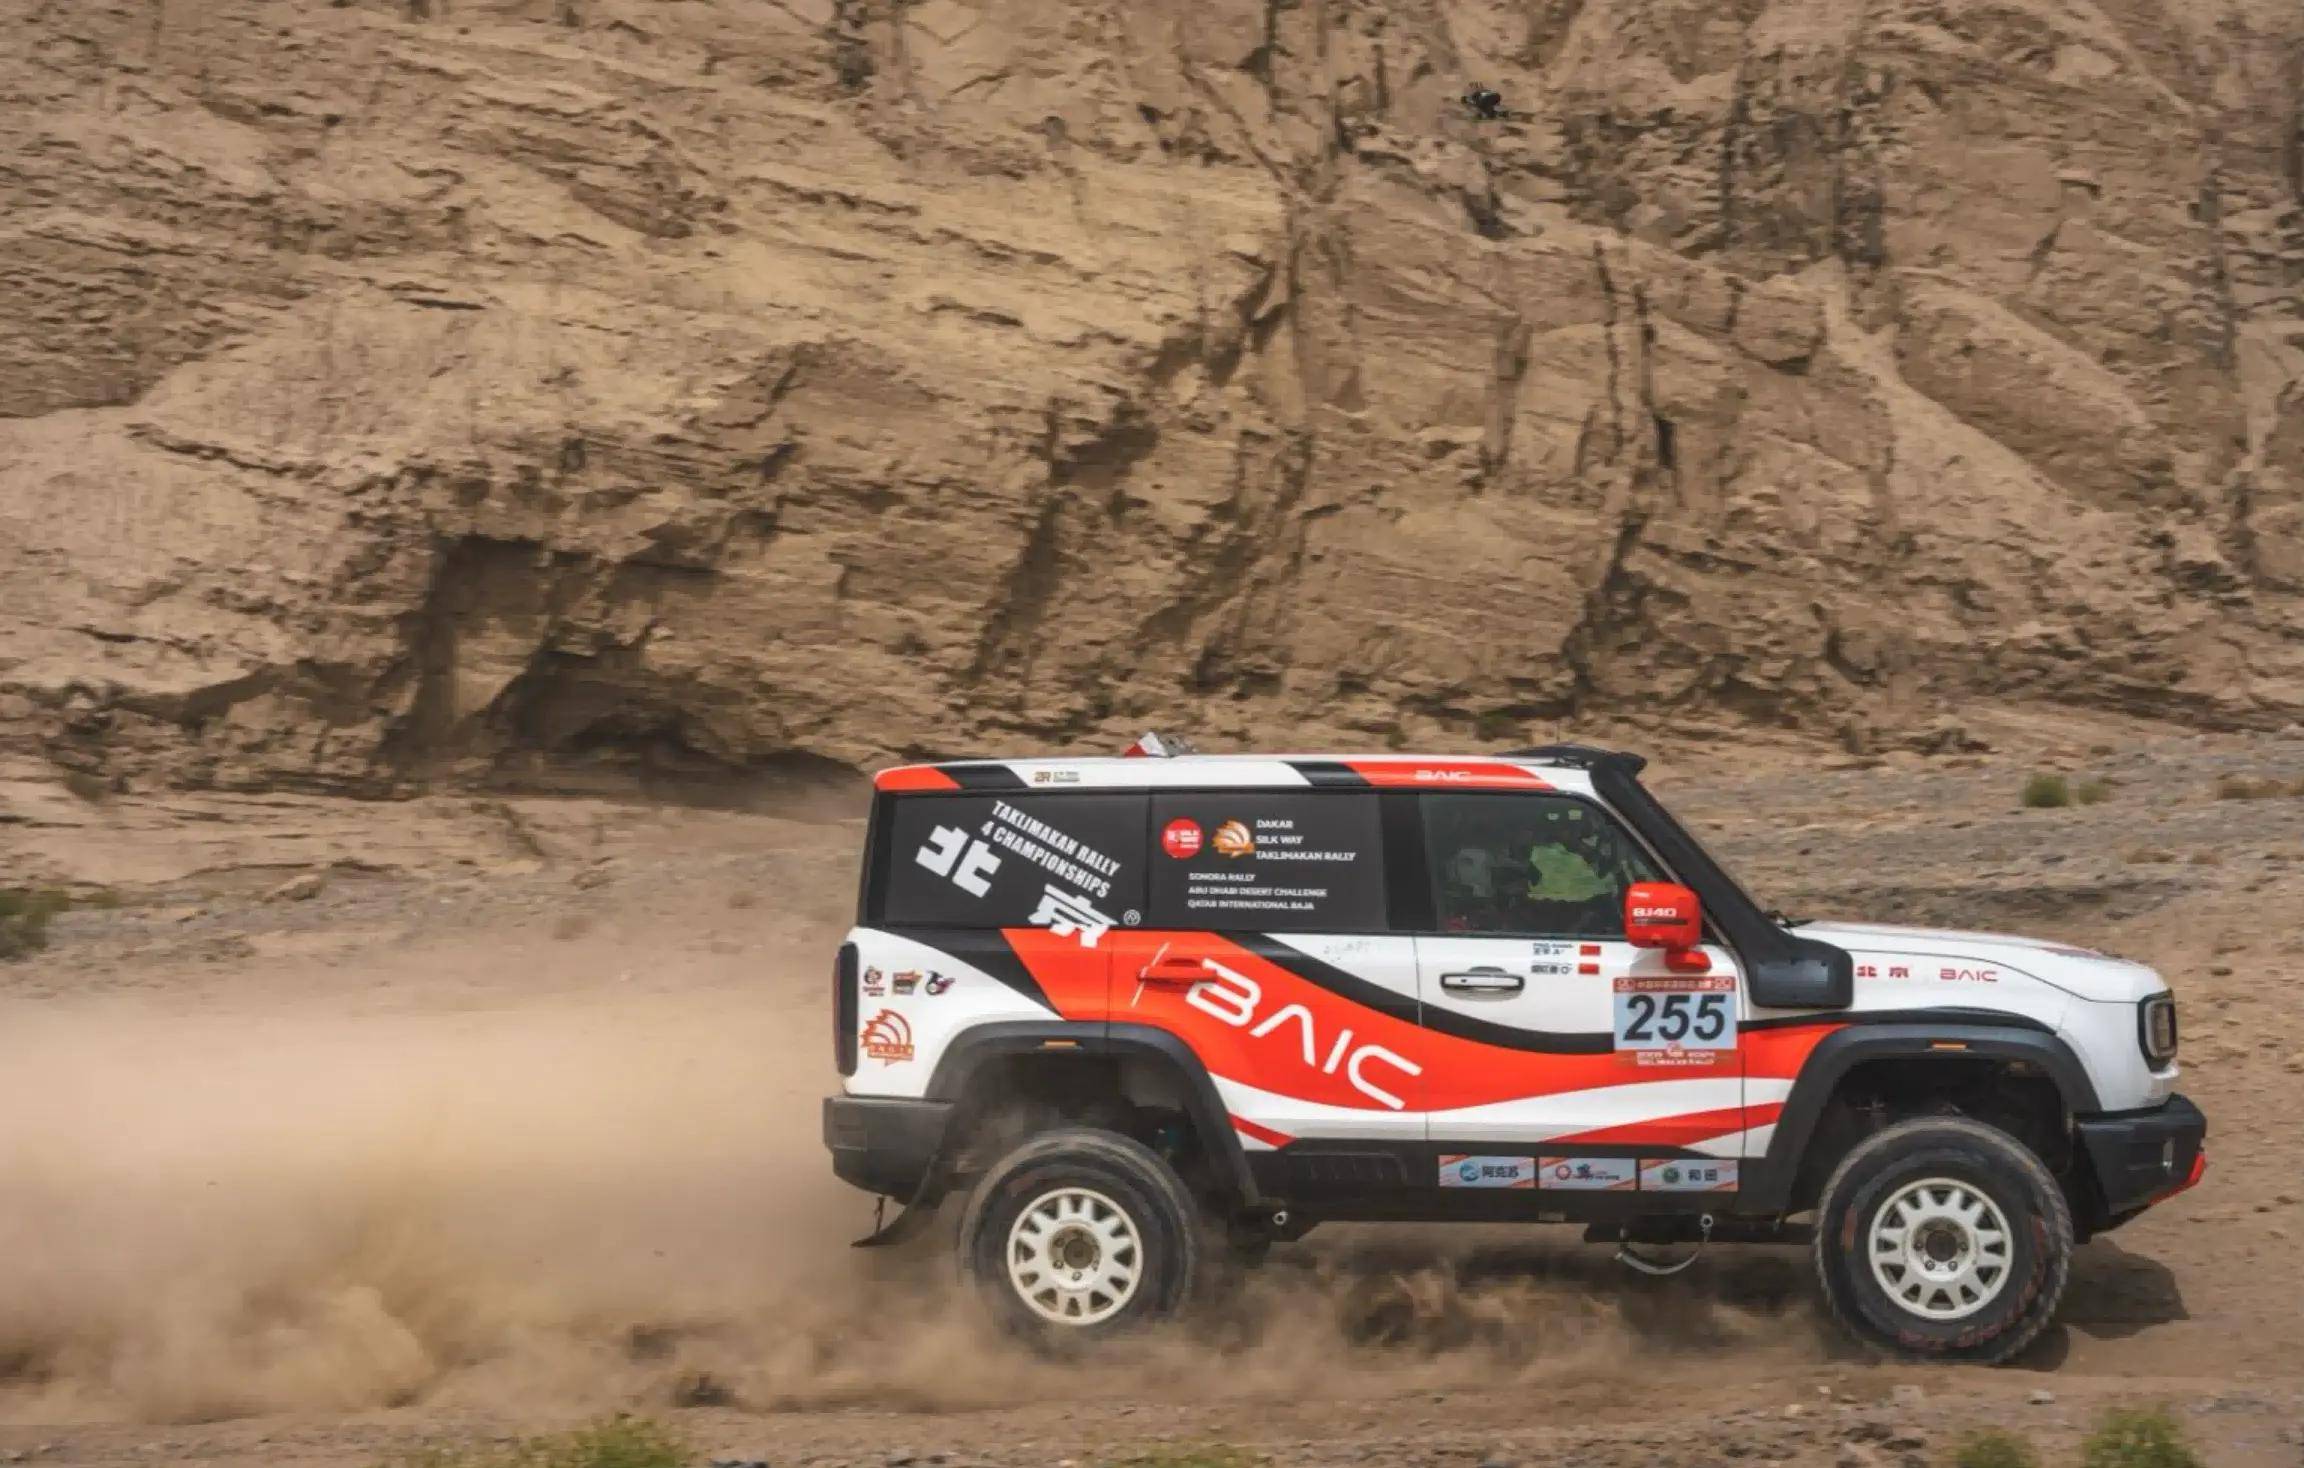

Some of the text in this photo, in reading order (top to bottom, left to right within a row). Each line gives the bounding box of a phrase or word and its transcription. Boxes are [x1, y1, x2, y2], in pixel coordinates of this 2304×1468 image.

[1256, 819, 1294, 830] DAKAR
[992, 800, 1121, 877] TAKLIMAKAN RALLY
[1256, 835, 1304, 845] SILK WAY
[980, 820, 1111, 898] 4 CHAMPIONSHIPS
[1256, 850, 1356, 862] TAKLIMAKAN RALLY
[1228, 873, 1256, 882] RALLY
[1239, 887, 1273, 897] DESERT
[1274, 888, 1328, 898] CHALLENGE
[1218, 900, 1289, 910] INTERNATIONAL
[1939, 968, 1998, 983] BAIC
[1623, 994, 1727, 1042] 255
[1185, 958, 1423, 1111] BAIC
